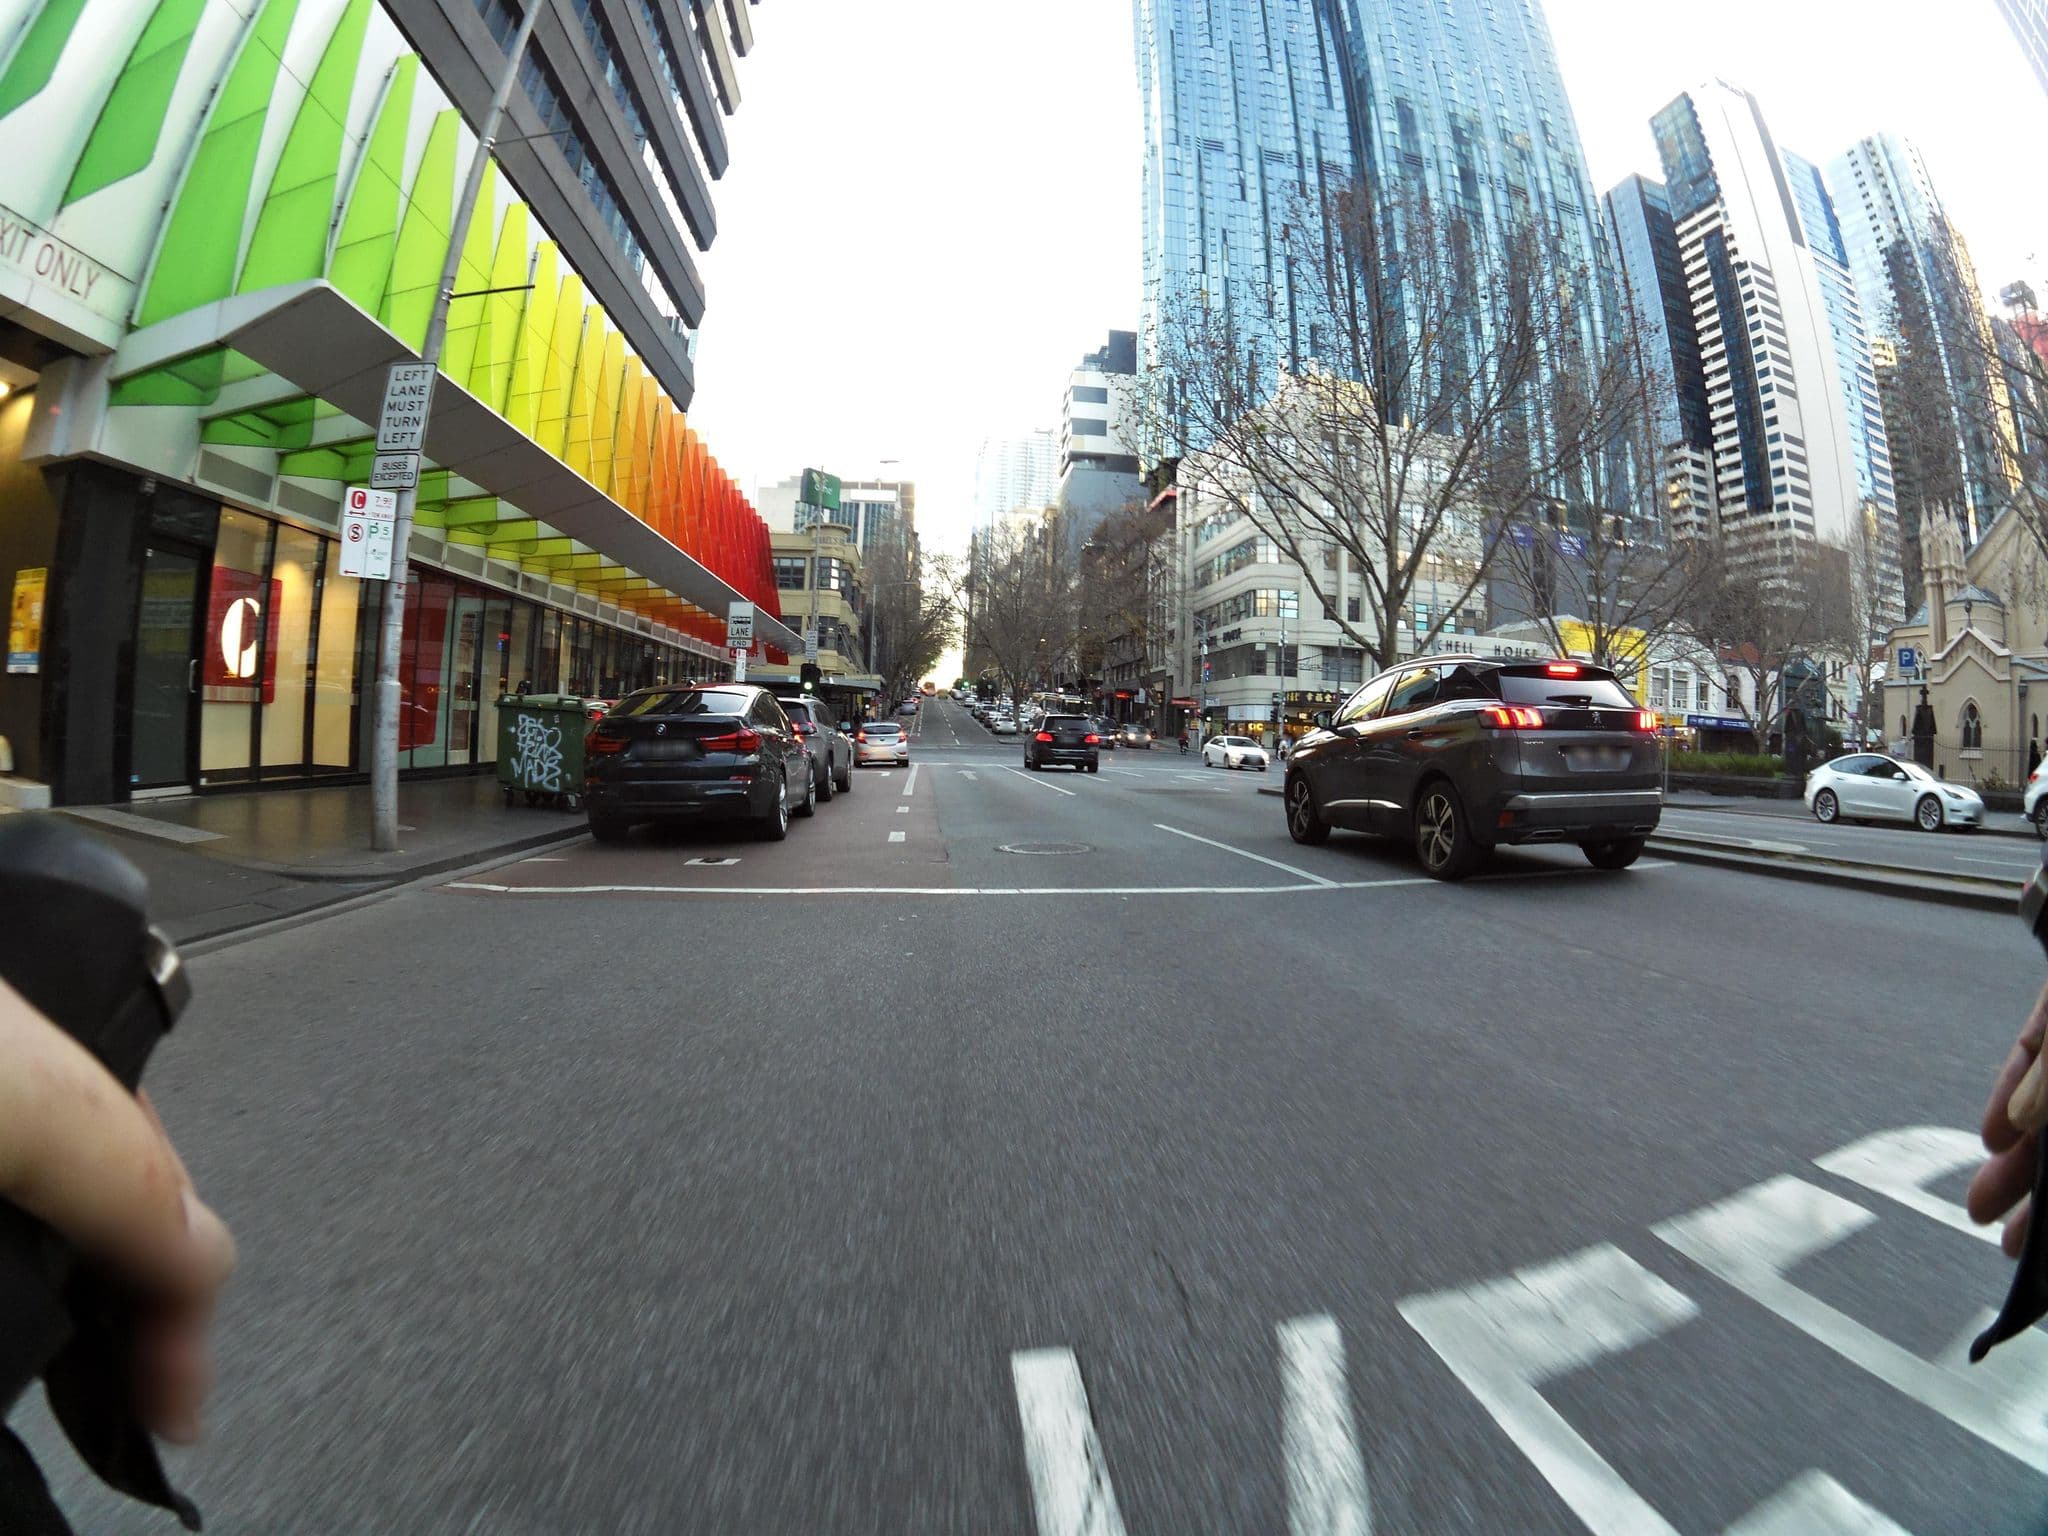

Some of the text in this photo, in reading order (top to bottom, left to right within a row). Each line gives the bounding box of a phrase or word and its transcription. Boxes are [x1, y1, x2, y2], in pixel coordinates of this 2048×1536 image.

[35, 243, 101, 300] ONLY
[395, 370, 429, 382] LEFT
[391, 385, 427, 397] LANE
[387, 400, 425, 412] MUST
[385, 416, 421, 428] TURN
[384, 432, 416, 444] LEFT
[382, 461, 408, 471] BUSES
[374, 471, 414, 481] EXCEPTED
[731, 627, 749, 636] LANE
[1494, 644, 1539, 658] HOUSE
[1902, 651, 1911, 665] P
